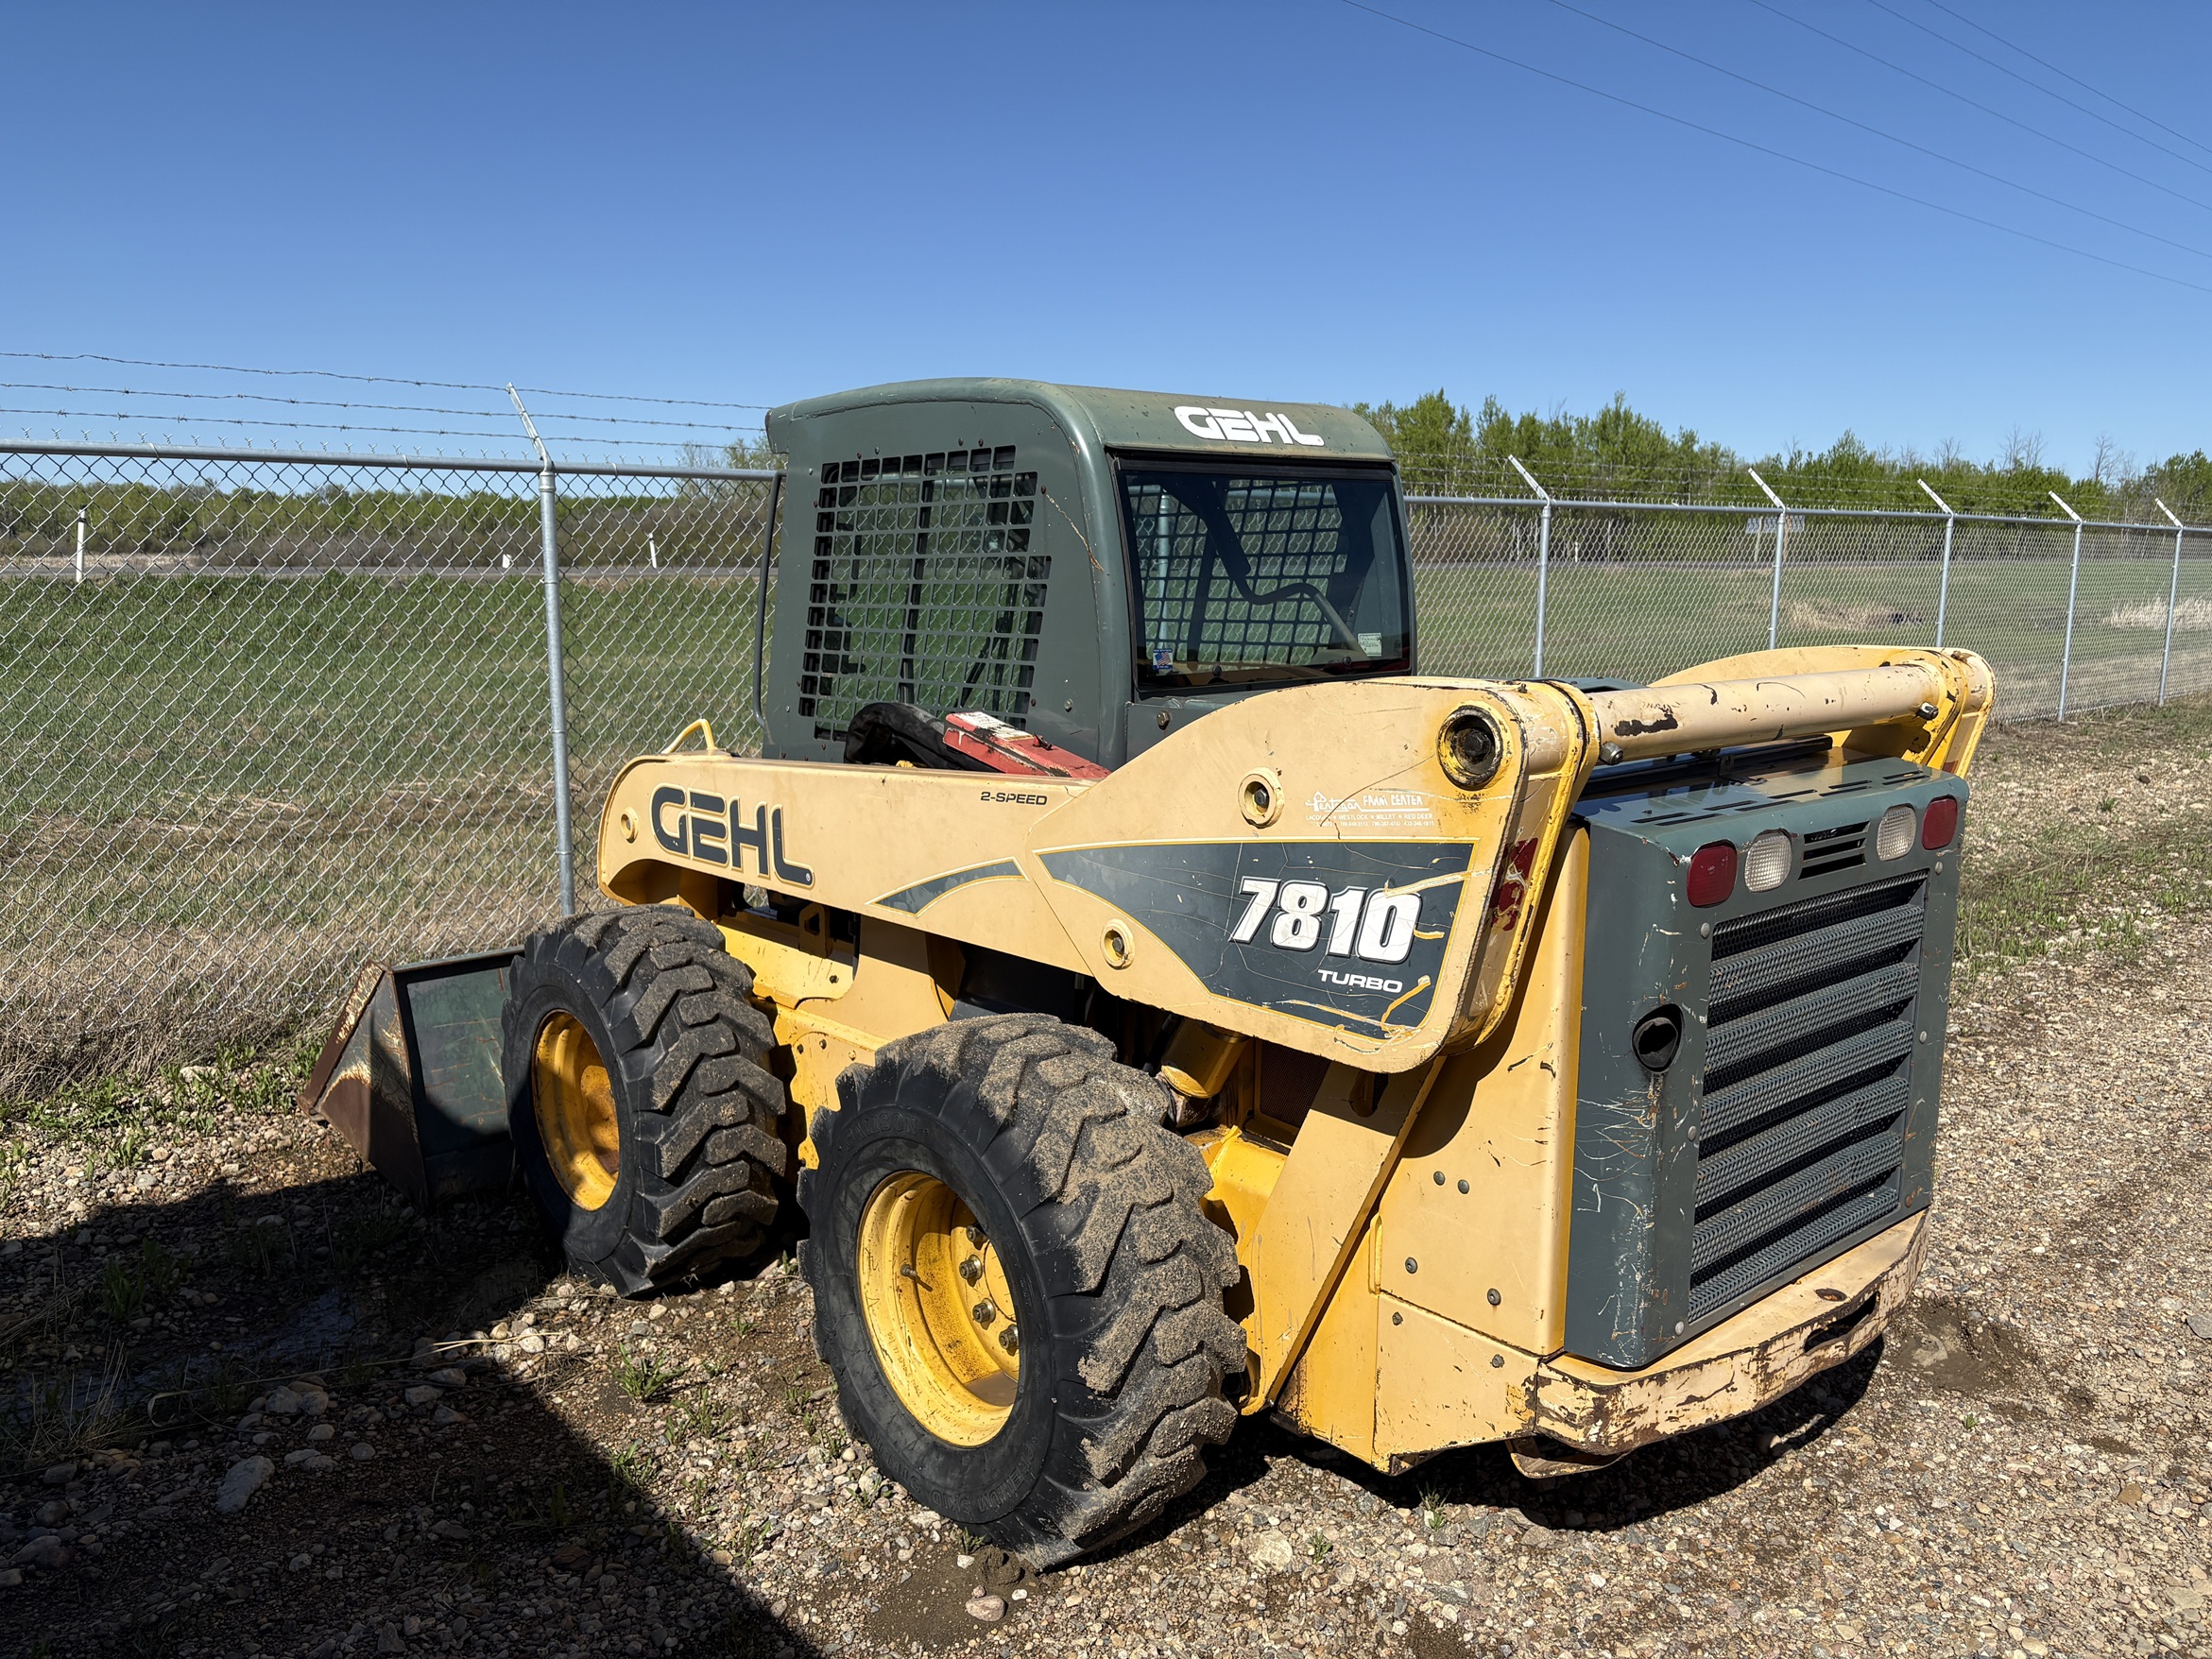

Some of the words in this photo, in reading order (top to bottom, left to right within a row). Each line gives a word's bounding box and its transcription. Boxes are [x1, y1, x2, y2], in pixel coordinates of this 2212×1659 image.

[1174, 405, 1325, 447] GEHL
[980, 791, 1048, 806] 2-SPEED
[1363, 795, 1388, 806] FARM
[651, 783, 814, 887] GEHL
[1228, 876, 1423, 966] 7810
[1317, 968, 1404, 994] TURBO
[931, 1488, 973, 1515] SKID
